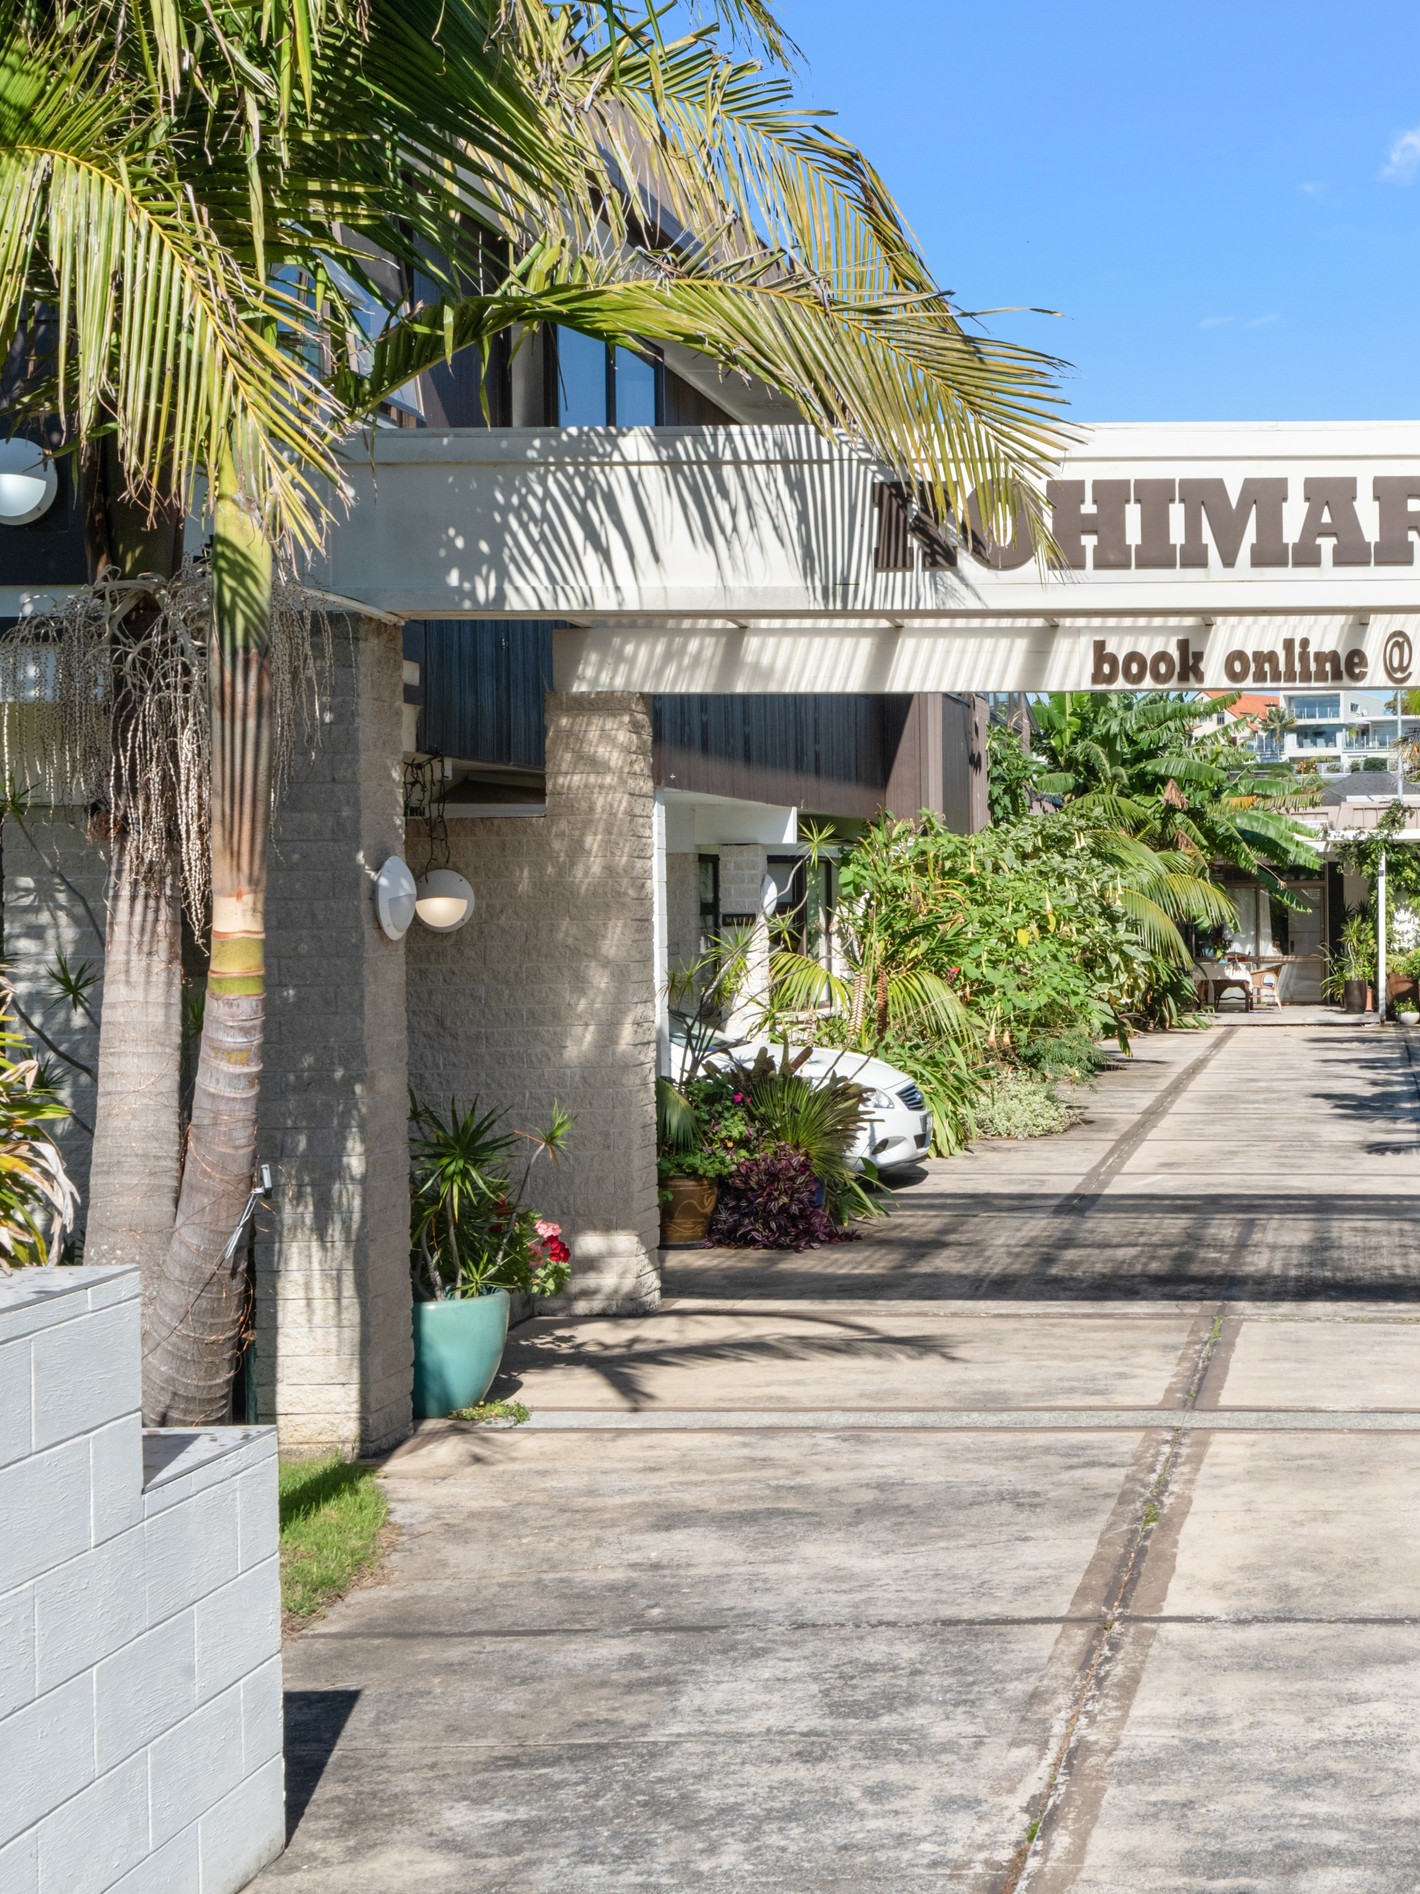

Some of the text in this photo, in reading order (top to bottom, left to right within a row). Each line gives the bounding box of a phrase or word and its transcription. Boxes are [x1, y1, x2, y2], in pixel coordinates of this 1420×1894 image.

[1091, 639, 1204, 686] book
[1224, 637, 1369, 684] online
[1383, 630, 1413, 685] @
